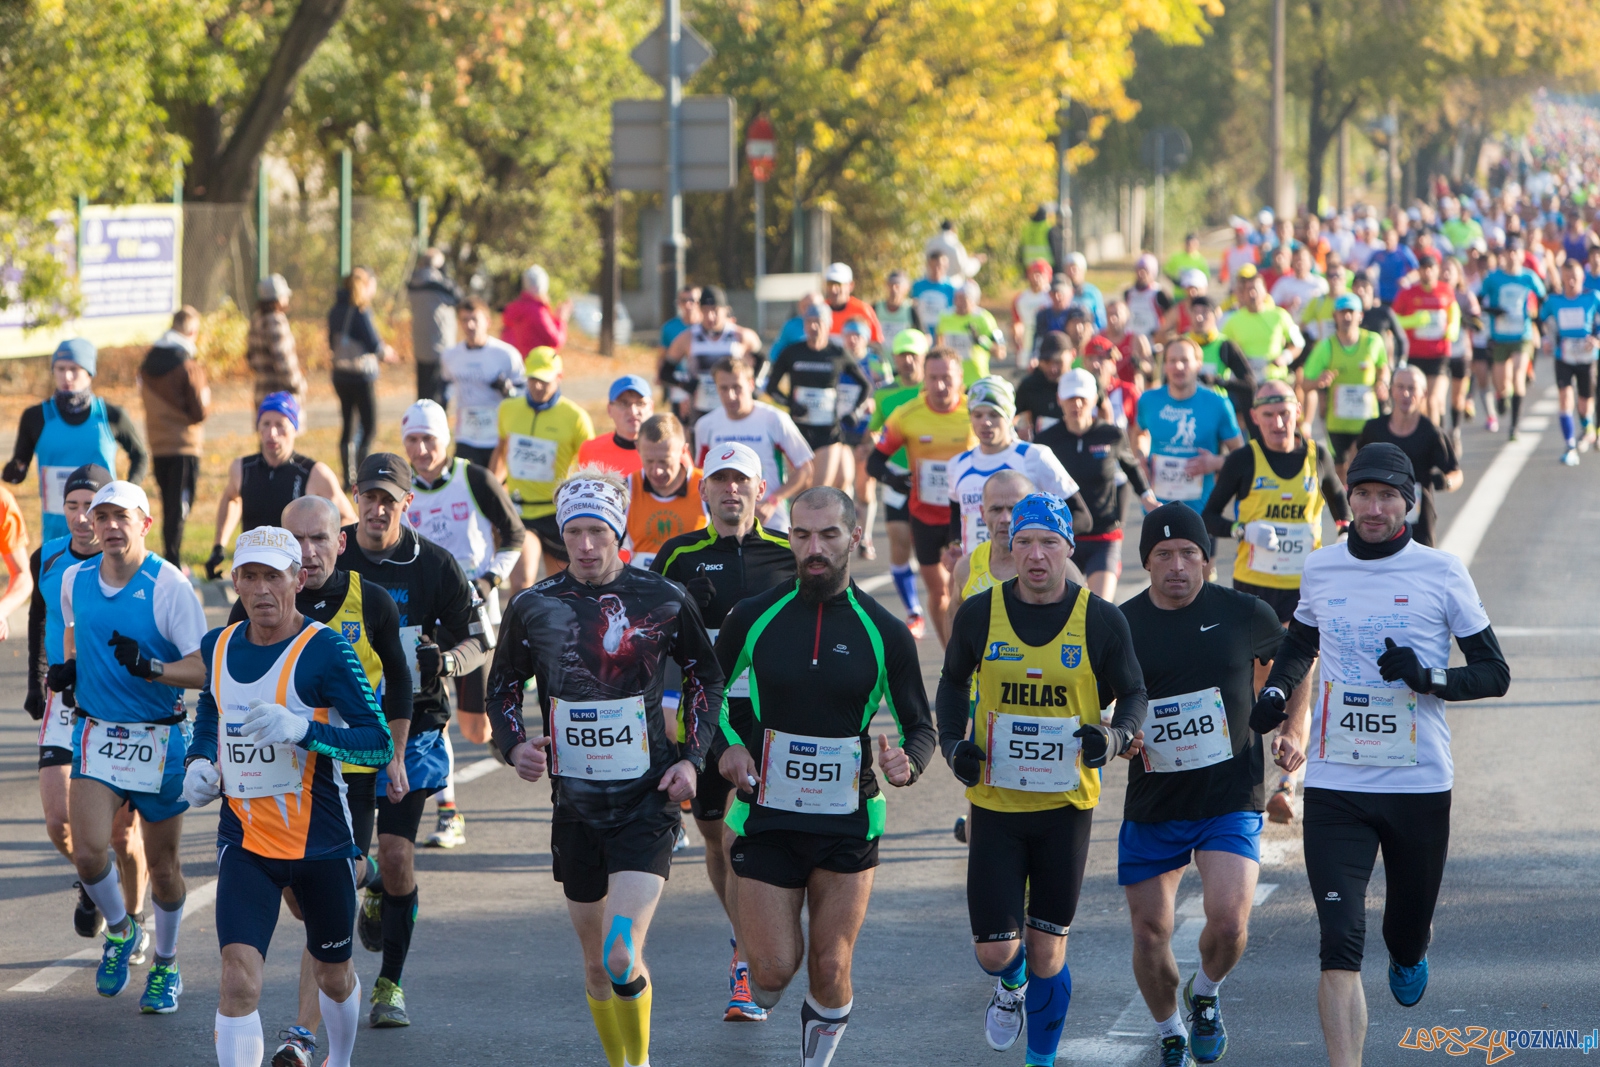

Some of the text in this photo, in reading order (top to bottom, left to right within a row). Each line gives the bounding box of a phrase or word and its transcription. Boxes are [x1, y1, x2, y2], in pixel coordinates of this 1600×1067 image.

[563, 502, 604, 518] EKSTREMALNY
[1266, 504, 1306, 519] JACEK
[705, 563, 724, 571] asics
[1001, 682, 1068, 707] ZIELAS
[1151, 714, 1215, 743] 2648
[1340, 711, 1397, 734] 4165
[565, 725, 633, 747] 6864
[1354, 737, 1381, 746] Szymon
[98, 741, 153, 762] 4270
[226, 742, 275, 764] 1670
[1009, 740, 1064, 761] 5521
[1175, 743, 1197, 752] Robert
[785, 759, 841, 782] 6951
[998, 931, 1017, 939] cep
